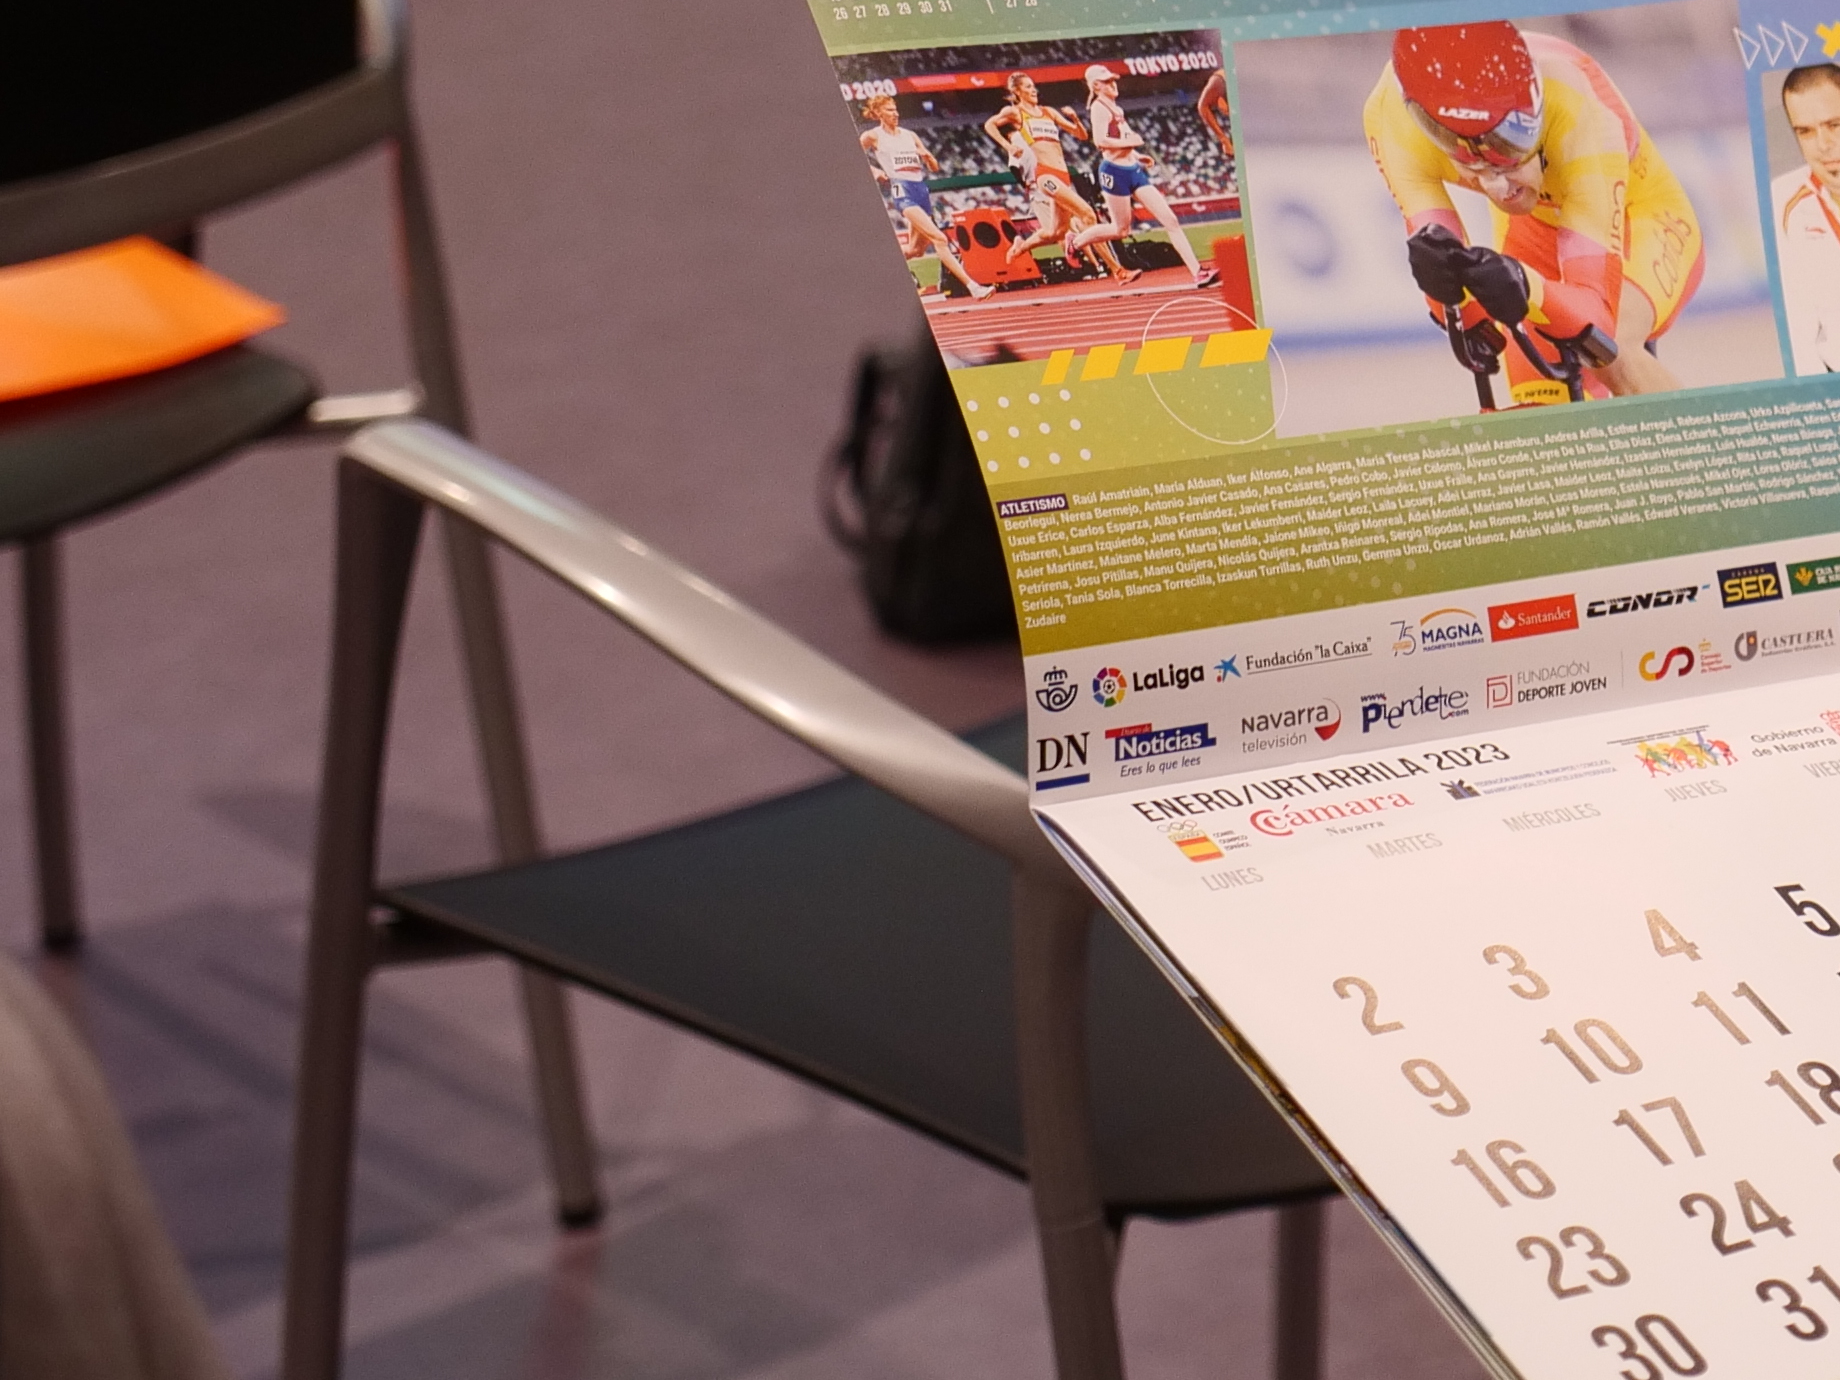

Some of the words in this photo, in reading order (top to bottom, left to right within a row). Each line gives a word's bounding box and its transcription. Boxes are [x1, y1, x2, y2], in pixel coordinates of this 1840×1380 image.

[1123, 54, 1179, 76] TOKYO
[1179, 50, 1218, 73] 2020
[853, 76, 897, 101] 2020
[1437, 106, 1490, 121] LAZER
[893, 184, 901, 197] 7
[1102, 174, 1113, 188] 12
[999, 497, 1066, 517] ATLETISMO
[1072, 491, 1097, 506] Raúl
[1099, 486, 1153, 504] Amatriain,
[1154, 479, 1185, 496] María
[1060, 509, 1093, 524] Nerea
[1094, 502, 1142, 521] Bermejo,
[1143, 497, 1185, 513] Antonio
[1062, 543, 1094, 558] Laura
[1095, 535, 1149, 554] Izquierdo,
[1150, 530, 1177, 545] June
[1178, 525, 1221, 541] Kintana,
[1069, 524, 1105, 540] Carlos
[1106, 518, 1152, 536] Esparza,
[1015, 565, 1044, 580] Asier
[1046, 558, 1098, 577] Martínez,
[1099, 551, 1142, 568] Maitane
[1144, 546, 1185, 563] Melero,
[1185, 539, 1218, 555] Marta
[1073, 574, 1100, 590] Josu
[1102, 569, 1143, 586] Pitillas,
[1723, 572, 1779, 603] SER
[1064, 591, 1095, 607] Tania
[1096, 588, 1124, 604] Sola,
[1125, 582, 1162, 599] Blanca
[1586, 585, 1699, 619] CONOR
[1023, 612, 1067, 629] Zudaire
[1517, 607, 1573, 628] Santander
[1421, 621, 1483, 644] MAGNA
[1760, 628, 1835, 651] CASTUERA
[1244, 649, 1314, 671] Fundación
[1314, 644, 1331, 661] "la
[1332, 637, 1373, 657] Caixa"
[1132, 663, 1206, 693] LaLiga
[1516, 661, 1591, 685] FUNDACIÓN
[1517, 683, 1567, 703] DEPORTE
[1567, 677, 1607, 698] JOVEN
[1240, 702, 1329, 735] Navarra
[1118, 729, 1203, 760] Noticias
[1241, 730, 1308, 753] televisión
[1750, 722, 1825, 745] Gobierno
[1036, 732, 1091, 773] DN
[1751, 745, 1772, 759] de
[1773, 736, 1838, 757] Navarra
[1120, 764, 1143, 777] Eres
[1145, 761, 1156, 774] lo
[1158, 760, 1179, 775] que
[1181, 755, 1201, 768] lees
[1131, 757, 1429, 823] ENERO/URTARRILA
[1423, 742, 1511, 771] 2023
[1200, 866, 1265, 892] LUNES
[1365, 832, 1444, 860] MARTES
[1501, 801, 1602, 834] MIÉRCOLES
[1662, 778, 1729, 803] JUEVES
[1325, 821, 1386, 837] Navarra
[1332, 976, 1405, 1036] 2
[1482, 944, 1550, 1000] 3
[1643, 909, 1703, 963] 4
[1400, 1057, 1471, 1117] 9
[1540, 1018, 1643, 1083] 10
[1691, 981, 1793, 1045] 11
[1451, 1140, 1557, 1208] 16
[1612, 1096, 1707, 1166] 17
[1516, 1226, 1631, 1300] 23
[1679, 1179, 1797, 1256] 24
[1590, 1314, 1708, 1380] 30
